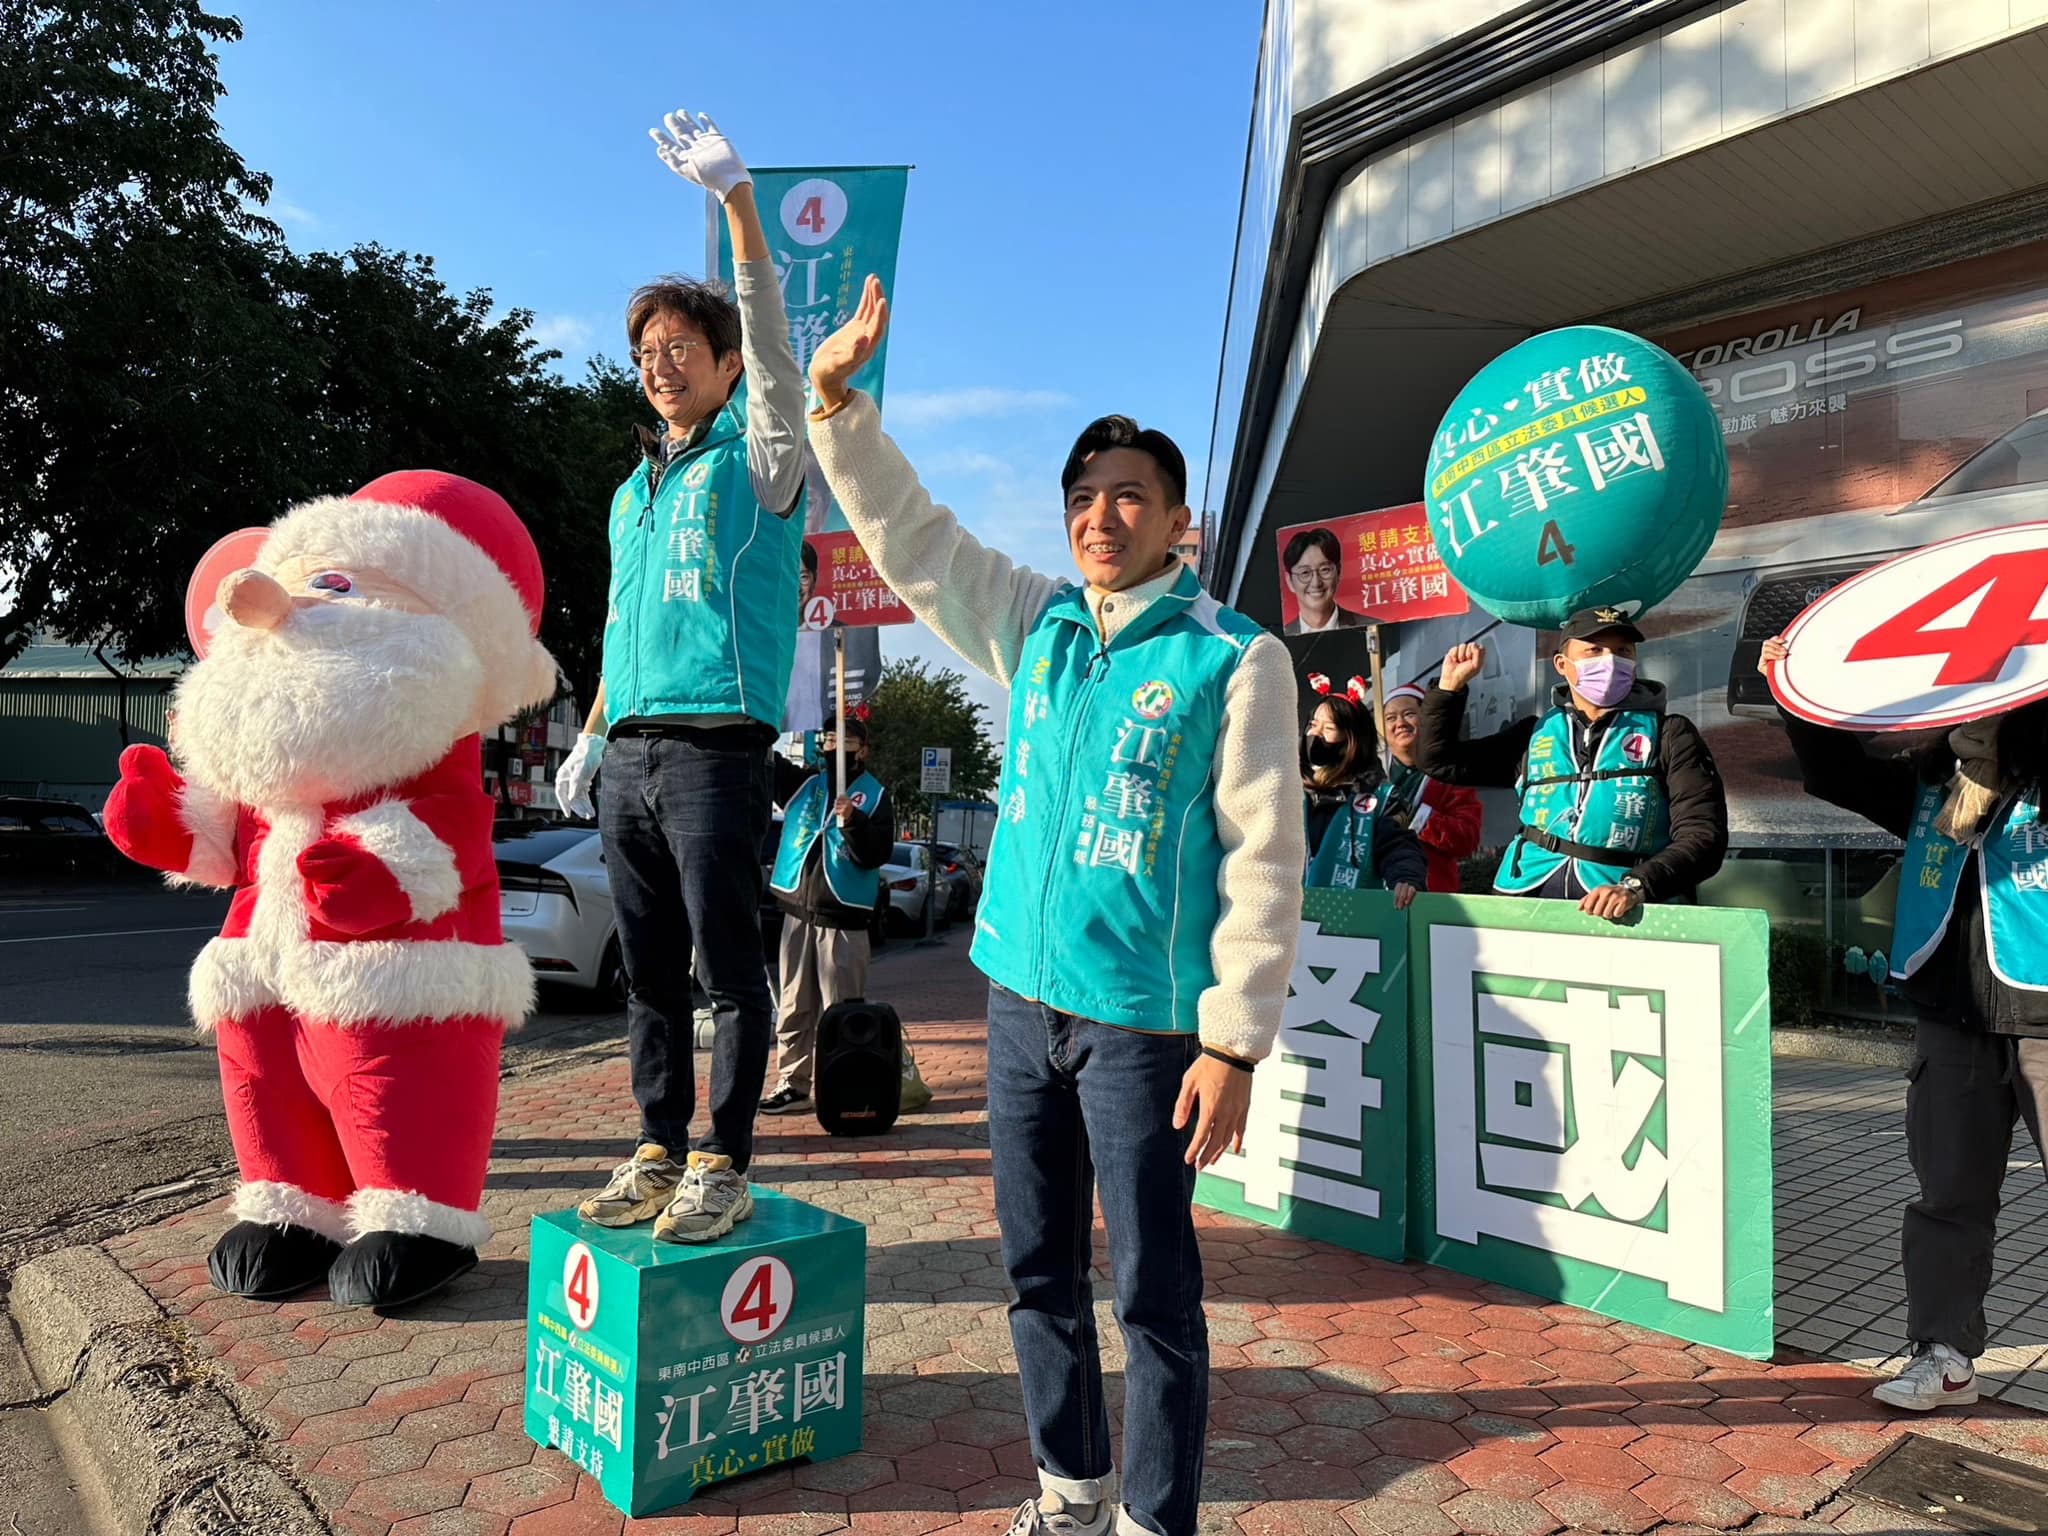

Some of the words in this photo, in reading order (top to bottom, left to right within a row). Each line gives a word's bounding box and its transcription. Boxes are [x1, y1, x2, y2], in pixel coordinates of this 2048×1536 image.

[795, 196, 825, 234] 4
[1439, 411, 1665, 558] 江肇國
[663, 489, 706, 604] 江肇國
[832, 545, 869, 566] 懇請
[1536, 519, 1575, 568] 4
[808, 599, 828, 626] 4
[832, 587, 899, 612] 江肇國
[1361, 572, 1448, 610] 江肇國
[1844, 547, 2048, 687] 4
[926, 751, 935, 765] P
[1623, 735, 1643, 760] 4
[1089, 716, 1168, 876] 江肇國
[1354, 793, 1373, 811] 4
[568, 1254, 590, 1321] 4
[731, 1263, 778, 1331] 4
[657, 1351, 730, 1382] 東南中西區
[754, 1323, 847, 1361] 立法委員候選人
[535, 1335, 625, 1453] 江肇國
[655, 1351, 848, 1460] 江肇國
